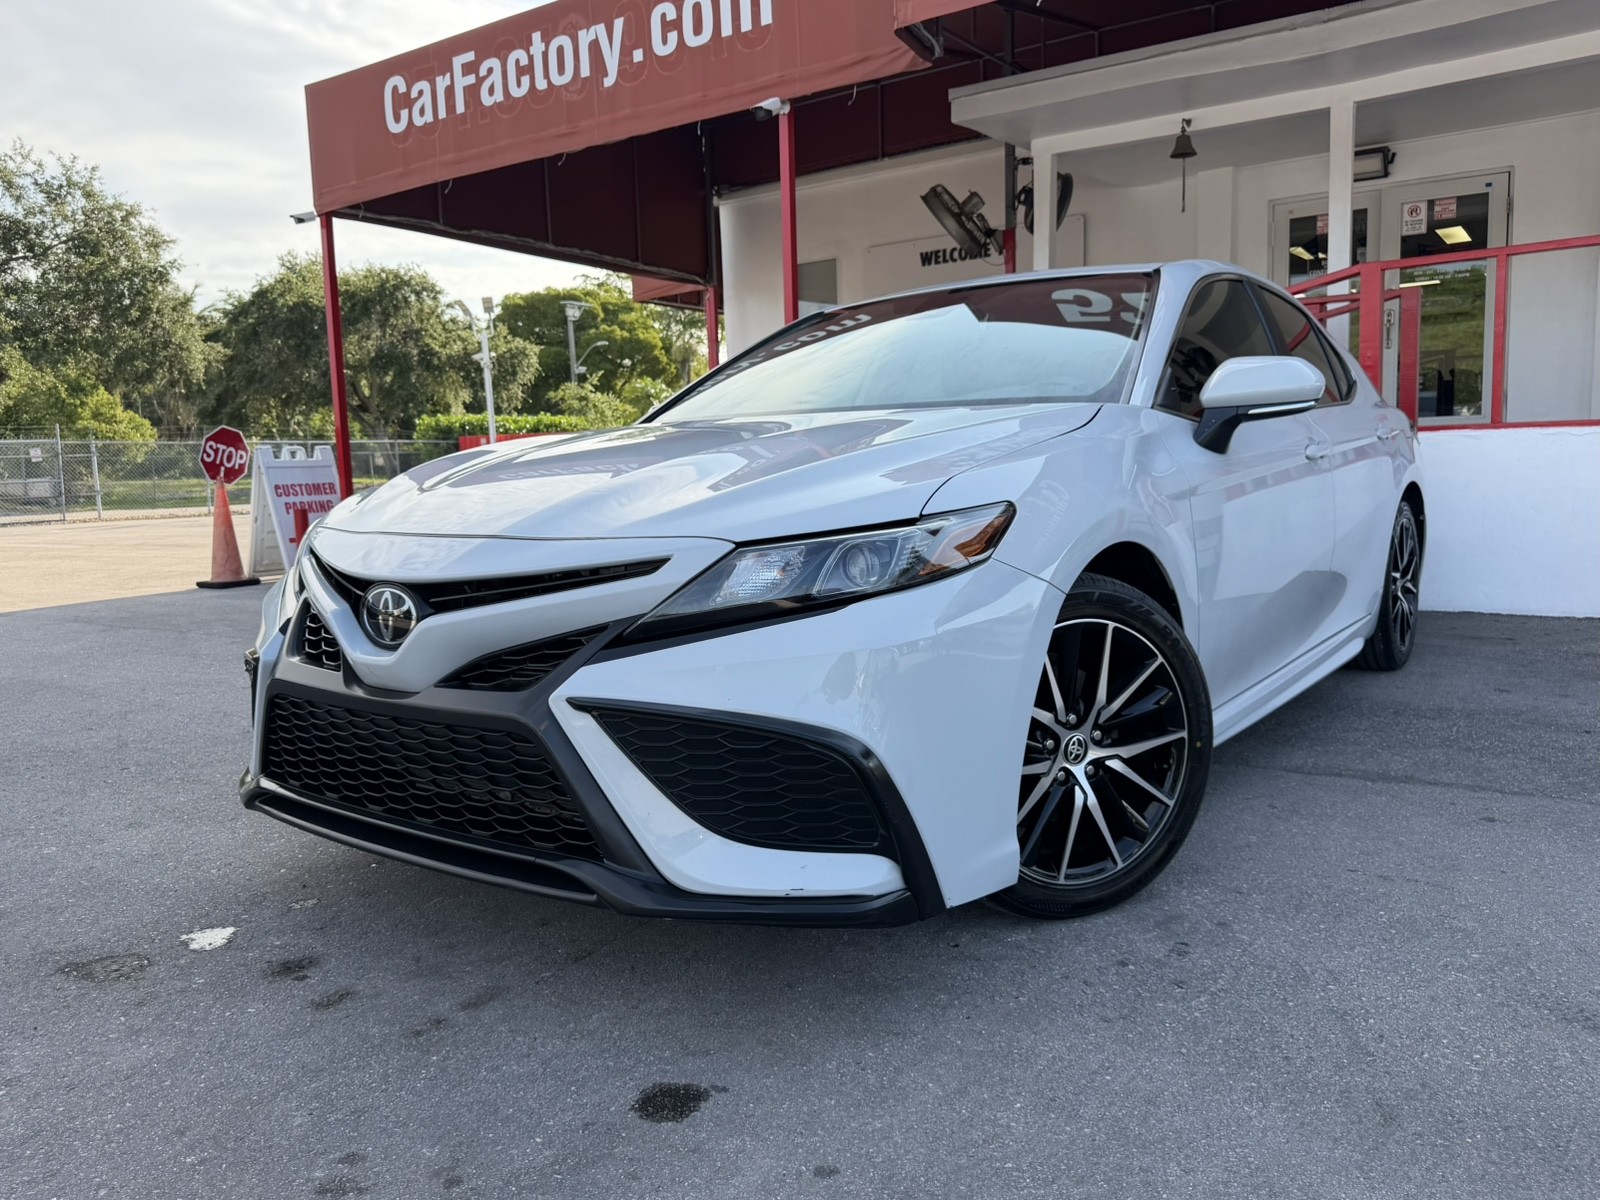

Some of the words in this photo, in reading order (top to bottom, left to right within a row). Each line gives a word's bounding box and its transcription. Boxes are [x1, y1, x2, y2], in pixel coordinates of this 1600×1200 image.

[384, 0, 773, 134] CarFactory.com
[203, 441, 246, 470] STOP
[273, 482, 337, 498] CUSTOMER
[284, 499, 335, 515] PARKING
